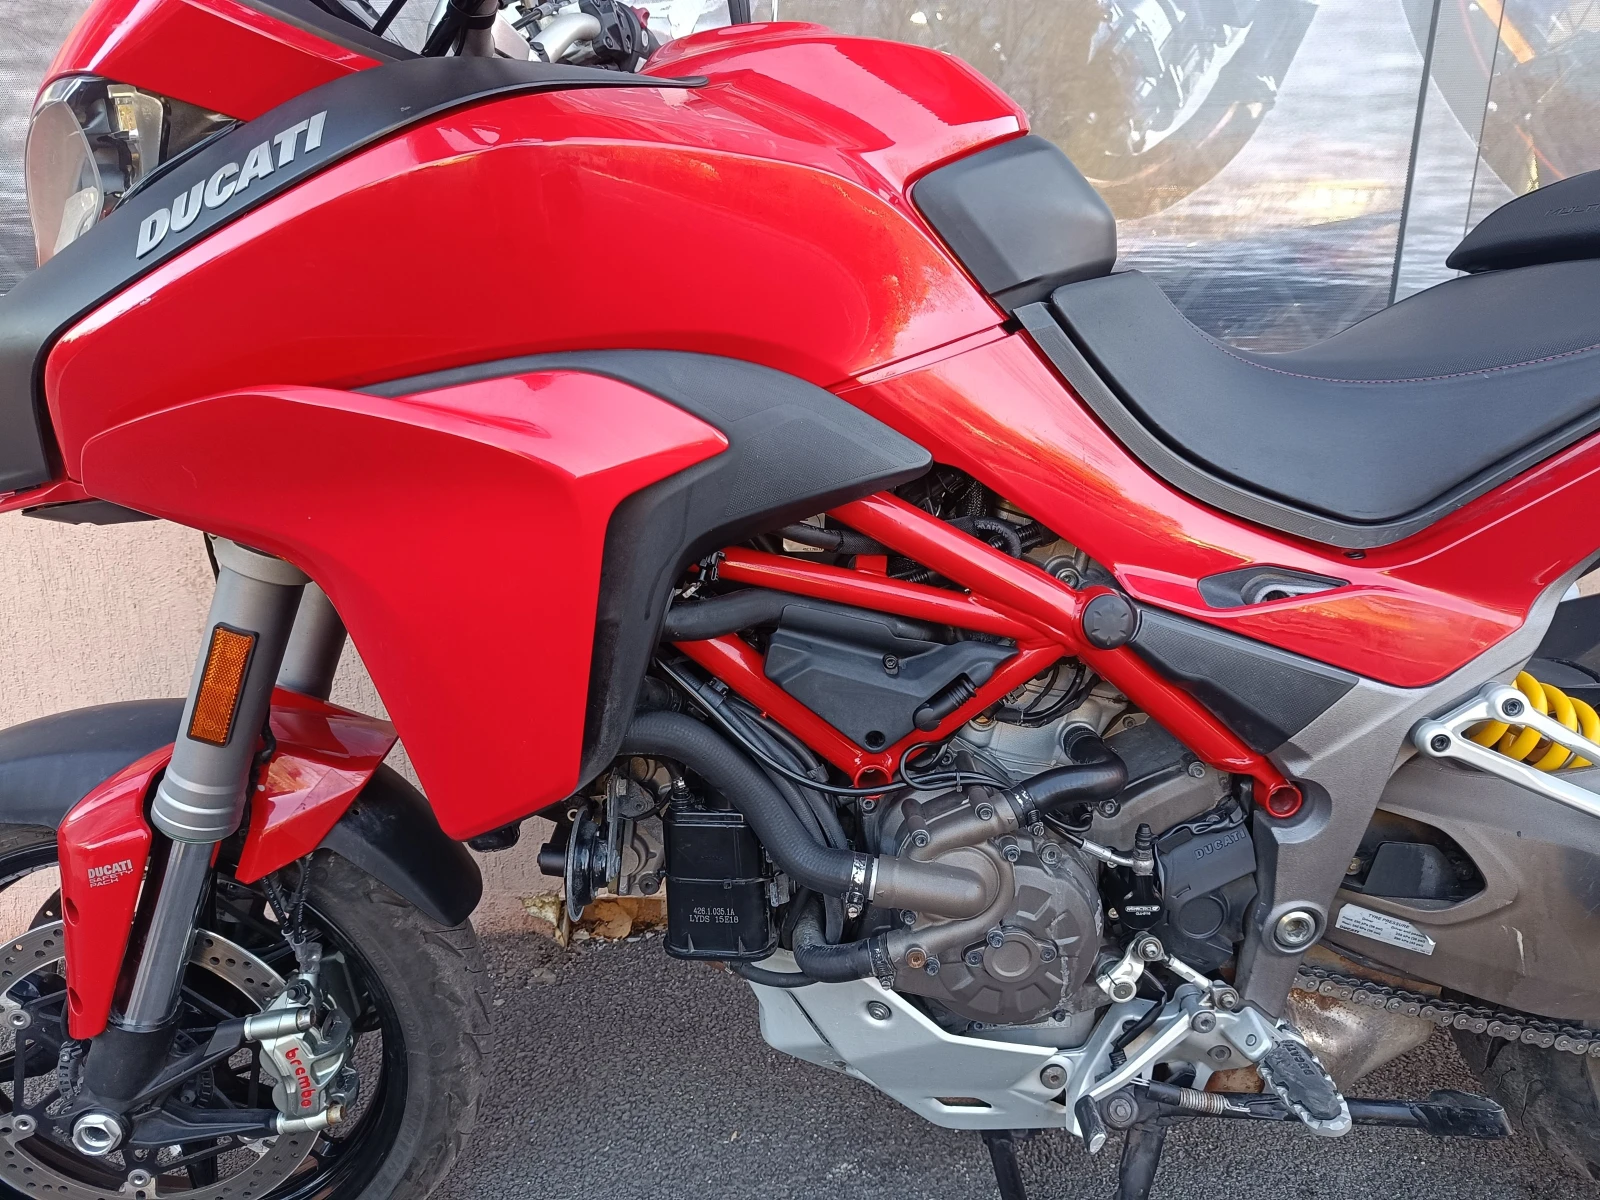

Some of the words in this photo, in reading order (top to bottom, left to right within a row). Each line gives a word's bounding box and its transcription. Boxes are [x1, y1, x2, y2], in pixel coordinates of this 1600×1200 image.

[135, 110, 328, 260] DUCATI
[1194, 828, 1247, 860] DUCATI
[87, 859, 133, 879] DUCATI
[89, 868, 134, 884] SAFETY
[689, 914, 710, 923] LYDS
[693, 907, 736, 916] 426.1.035.1A
[285, 1047, 316, 1108] brembo
